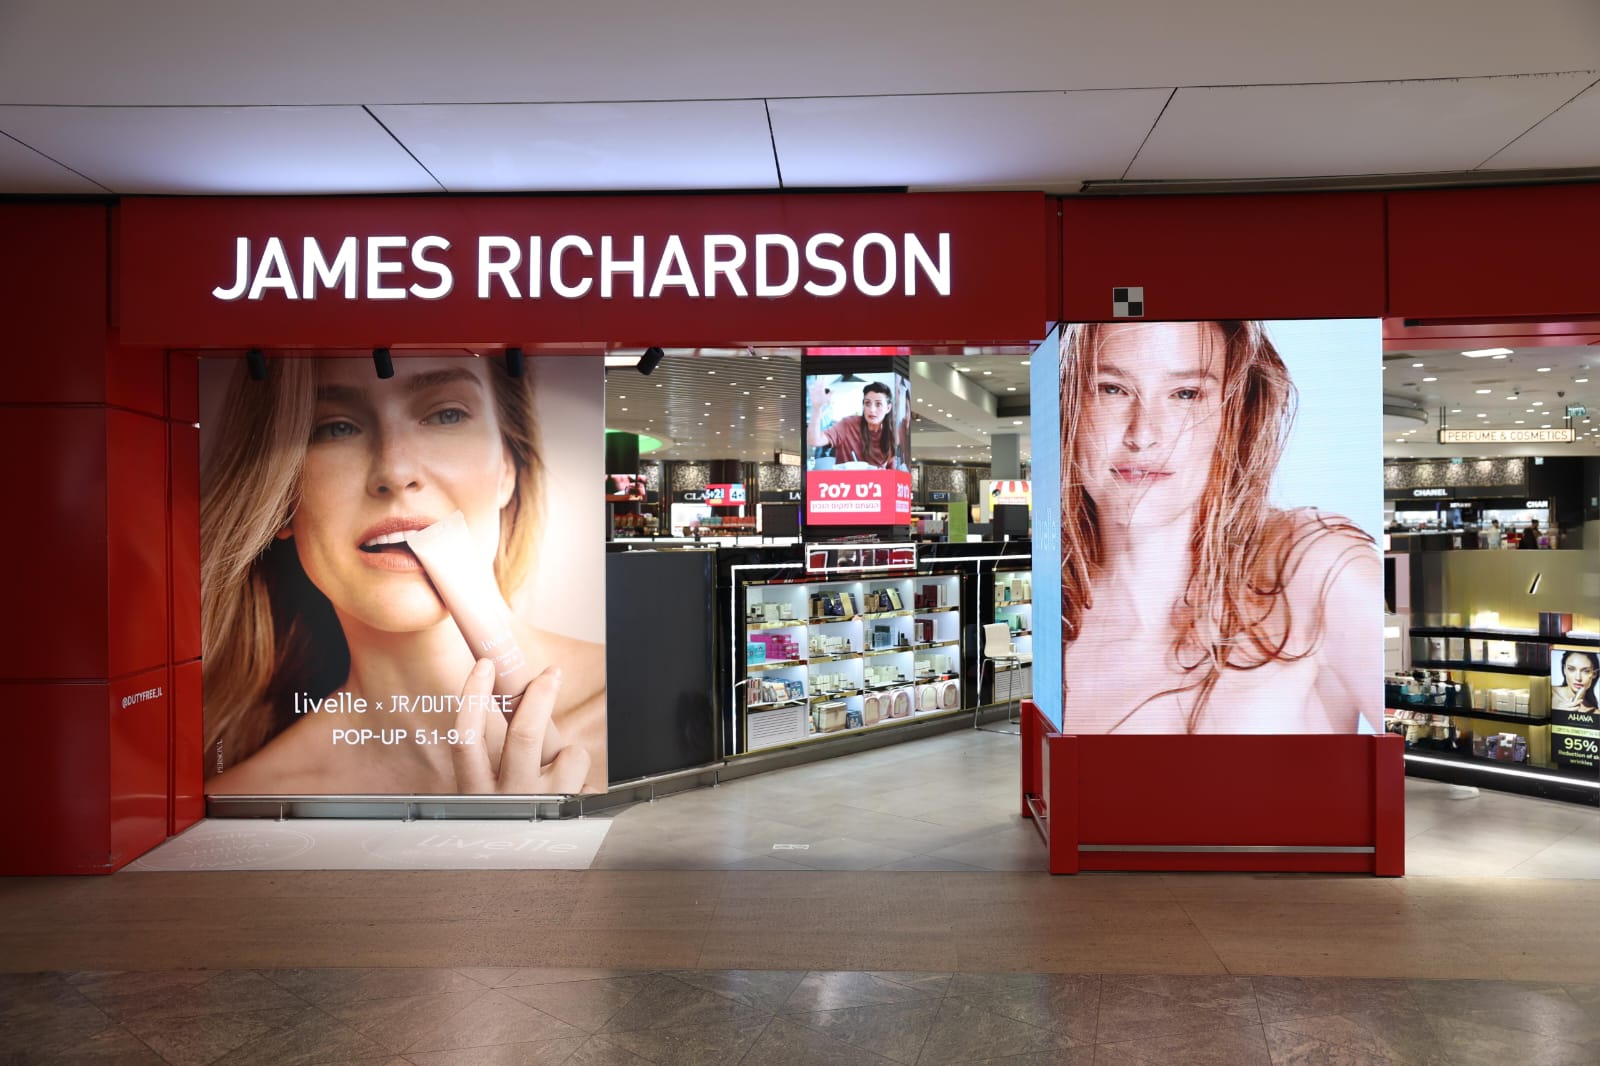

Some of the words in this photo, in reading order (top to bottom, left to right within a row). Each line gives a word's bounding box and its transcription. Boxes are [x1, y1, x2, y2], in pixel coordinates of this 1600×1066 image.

[212, 236, 454, 301] JAMES
[477, 232, 952, 299] RICHARDSON
[1448, 431, 1497, 441] PERFUME
[1500, 431, 1507, 440] &
[1510, 430, 1568, 441] COSMETICS
[1413, 489, 1448, 497] CHANEL
[294, 692, 368, 713] livelle
[1567, 713, 1594, 723] AHAVA
[332, 728, 408, 745] POP-UP
[415, 728, 477, 745] 5.1-9.2
[1564, 737, 1598, 753] 95%
